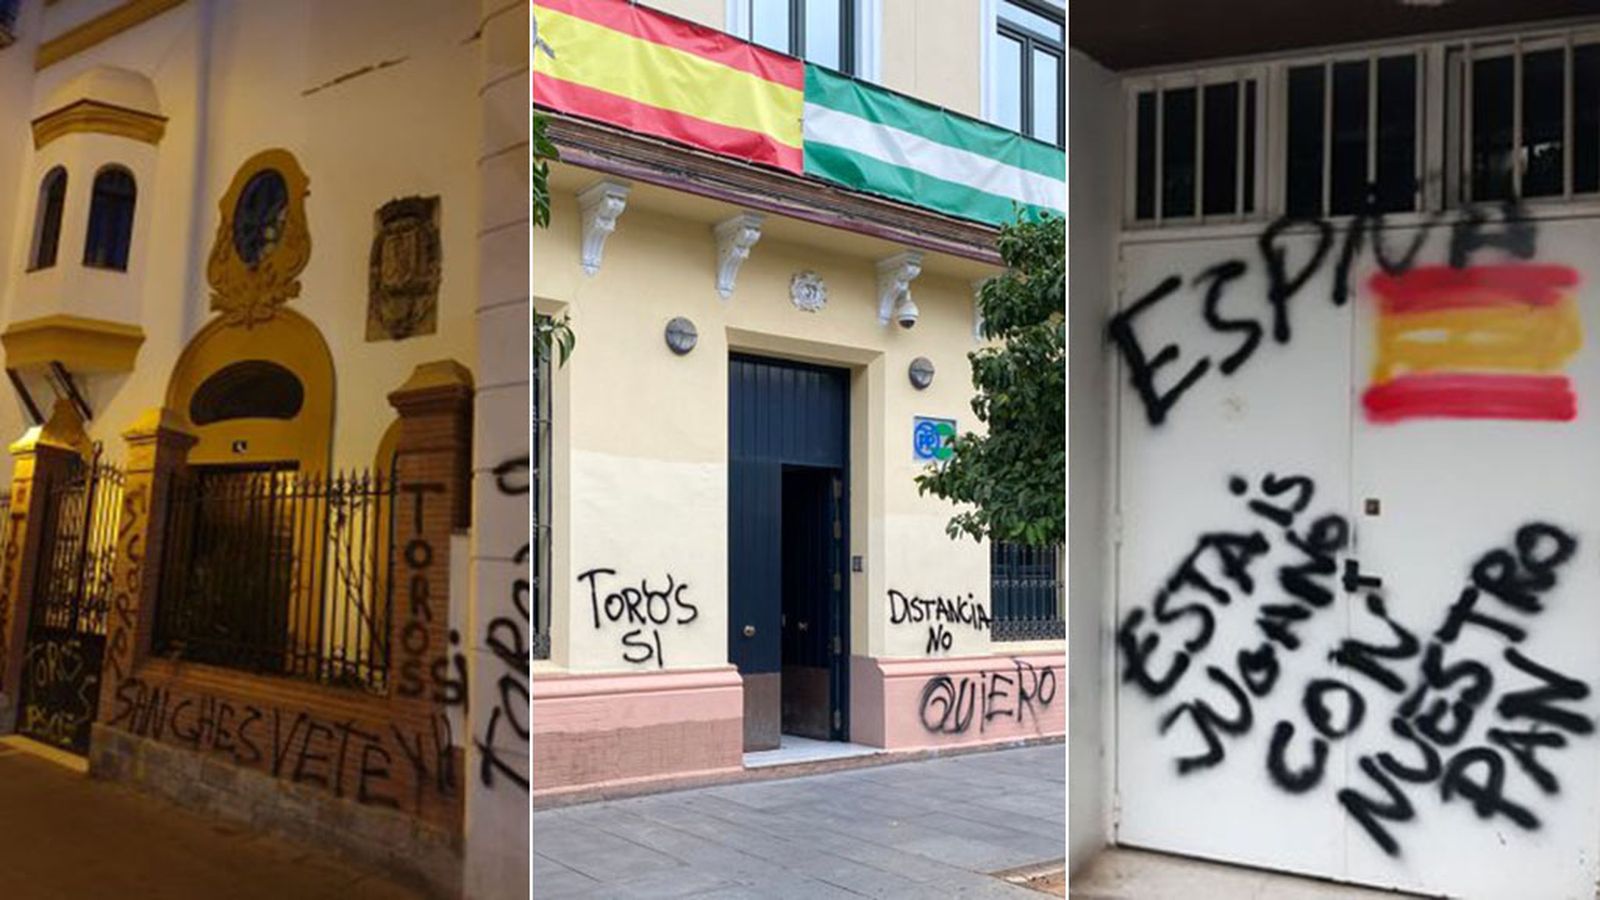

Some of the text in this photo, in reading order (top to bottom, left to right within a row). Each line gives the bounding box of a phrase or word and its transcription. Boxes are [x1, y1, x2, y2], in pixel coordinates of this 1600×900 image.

[577, 568, 698, 628] TOROS
[622, 629, 664, 667] SI
[926, 627, 953, 654] NO
[1338, 521, 1579, 856] NUESTRO
[1440, 648, 1596, 832] PAN
